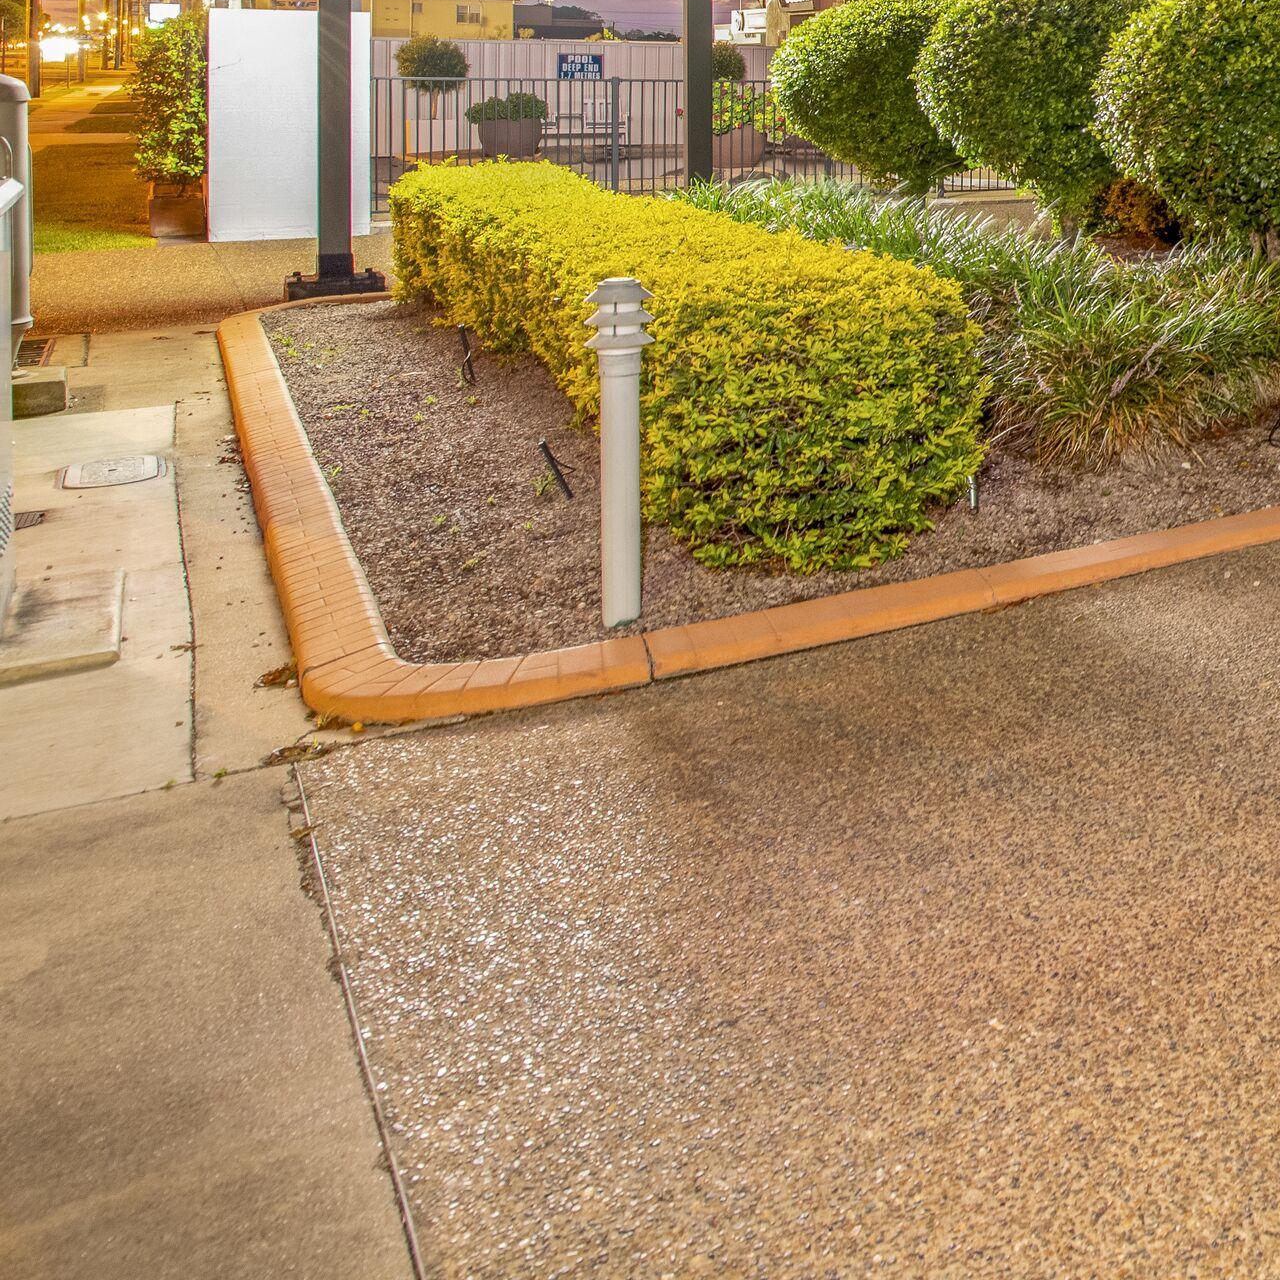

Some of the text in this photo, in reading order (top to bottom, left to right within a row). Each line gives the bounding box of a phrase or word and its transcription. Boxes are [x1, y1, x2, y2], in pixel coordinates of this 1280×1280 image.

[567, 55, 594, 63] POOL
[562, 63, 599, 72] DEEP END
[560, 71, 601, 80] 1.7 METRES
